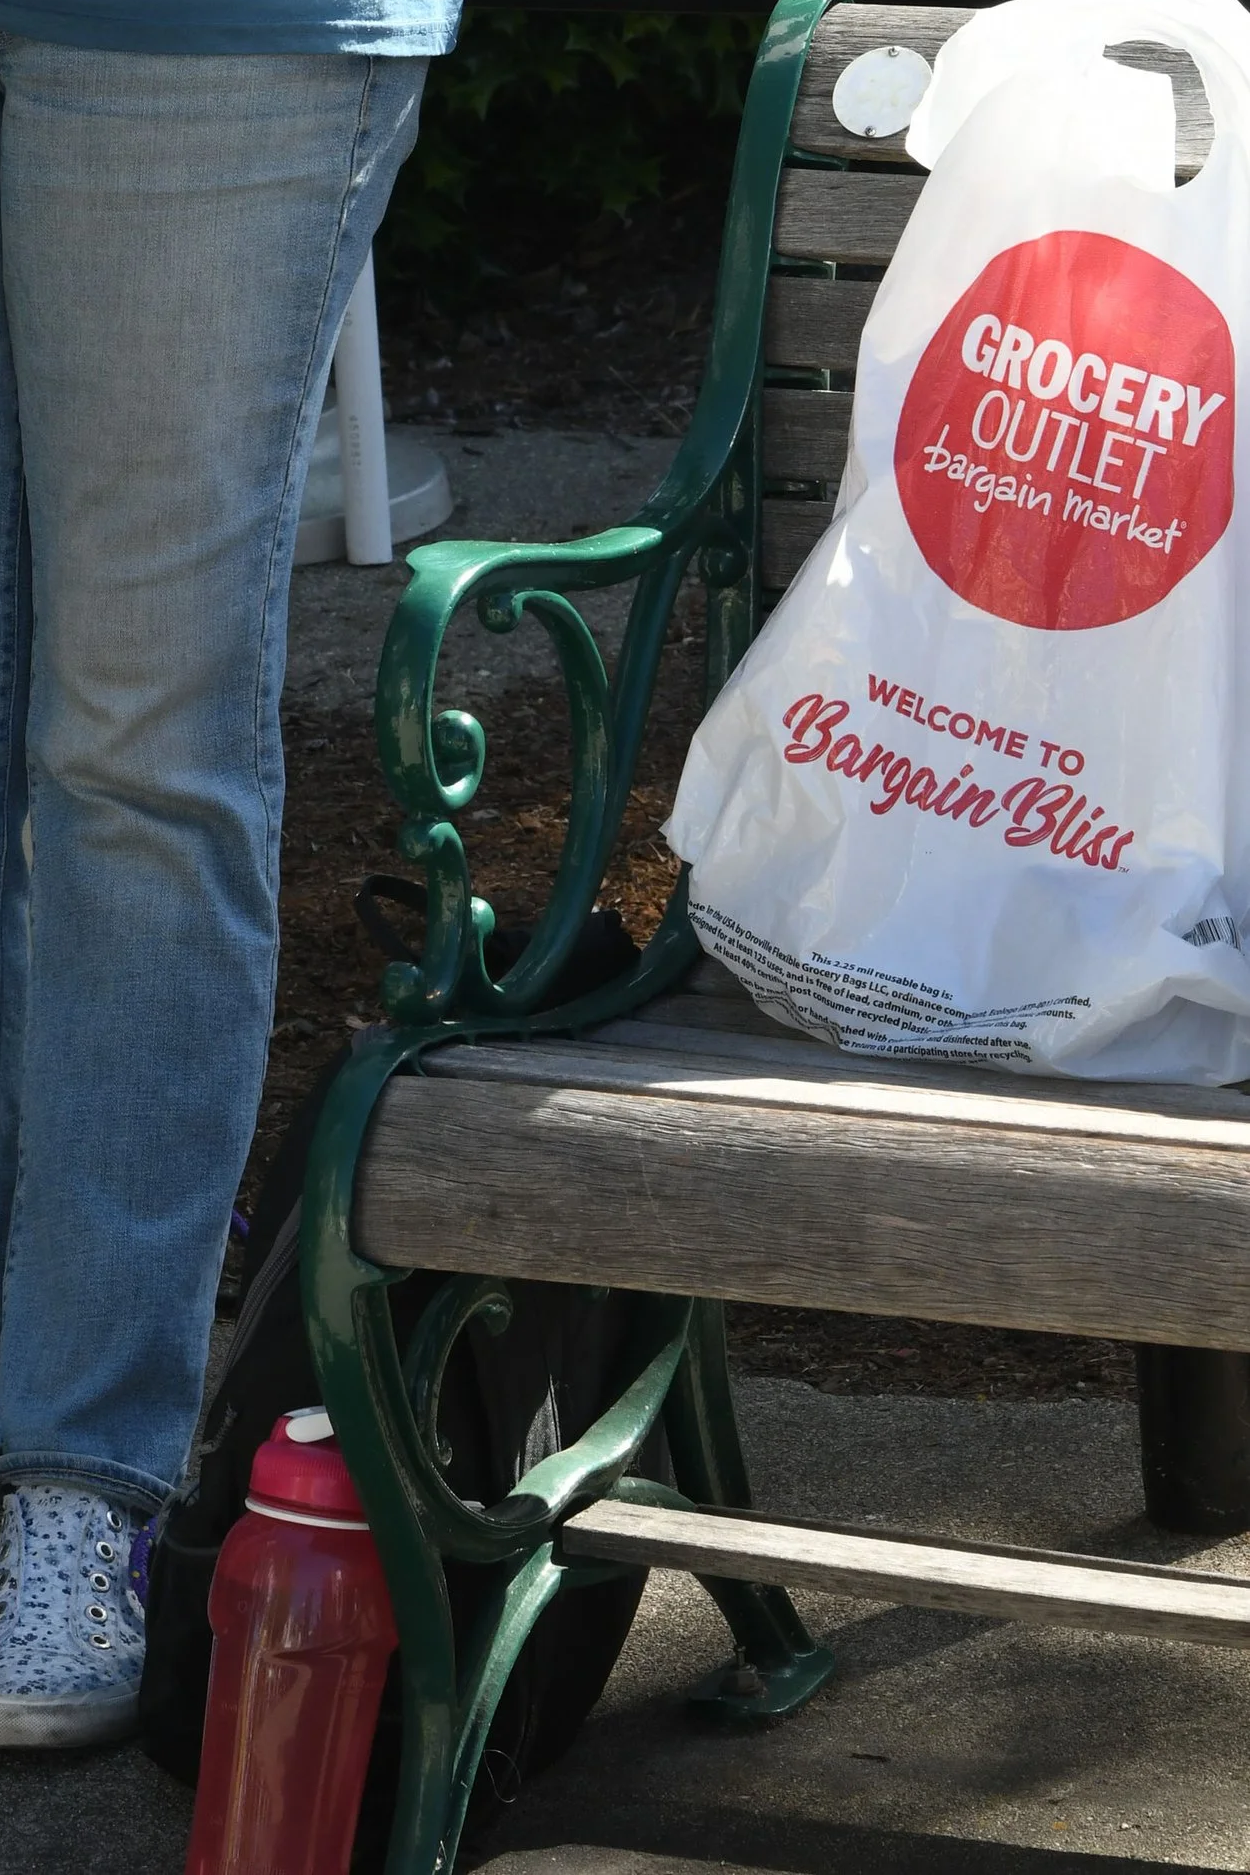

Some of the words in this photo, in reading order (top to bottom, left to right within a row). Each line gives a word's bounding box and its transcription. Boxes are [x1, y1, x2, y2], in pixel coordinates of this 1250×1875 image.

[961, 313, 1227, 447] GROCERY
[923, 424, 1051, 513] bargain
[1062, 488, 1183, 554] market
[971, 389, 1168, 500] OUTLET
[867, 673, 1030, 759] WELCOME
[1039, 739, 1086, 776] TO
[782, 693, 1001, 828] Bargain
[1000, 776, 1135, 871] Bliss
[688, 900, 706, 912] ade
[706, 905, 714, 916] in
[712, 909, 724, 923] the
[722, 915, 736, 931] USA
[735, 923, 746, 938] by
[745, 930, 772, 953] Oroville
[771, 946, 801, 969] Flexible
[801, 962, 841, 983] Grocery
[842, 973, 867, 991] Bags
[868, 981, 890, 997] LLC,
[891, 989, 943, 1013] ordinance
[1053, 994, 1092, 1008] Certified,
[688, 910, 718, 936] designed
[717, 928, 728, 942] for
[727, 936, 736, 946] at
[735, 940, 754, 957] least
[753, 951, 767, 965] 125
[766, 960, 785, 978] uses,
[786, 970, 804, 983] and
[805, 975, 814, 985] is
[815, 978, 833, 993] free
[833, 987, 846, 997] of
[845, 989, 871, 1007] lead,
[872, 998, 923, 1021] cadmium,
[924, 1014, 937, 1024] or
[712, 942, 722, 953] At
[722, 946, 742, 963] least
[741, 956, 757, 974] 40%
[756, 968, 789, 988] certifid
[789, 985, 812, 998] post
[812, 990, 856, 1016] consumer
[856, 1009, 901, 1028] recycled
[900, 1019, 931, 1035] plastic
[812, 951, 832, 966] This
[834, 960, 855, 972] 2.25
[856, 967, 875, 977] mil
[874, 971, 920, 991] reusable
[919, 983, 940, 999] bag
[941, 990, 954, 1001] is:
[797, 1005, 809, 1014] or
[809, 1008, 829, 1024] hand
[866, 1028, 888, 1043] with
[892, 1044, 950, 1059] participating
[950, 1048, 973, 1058] store
[989, 1049, 1033, 1064] recycling.
[942, 1034, 989, 1046] disinfected
[989, 1036, 1012, 1048] after
[1013, 1040, 1032, 1050] use.
[1009, 1019, 1028, 1030] bag.
